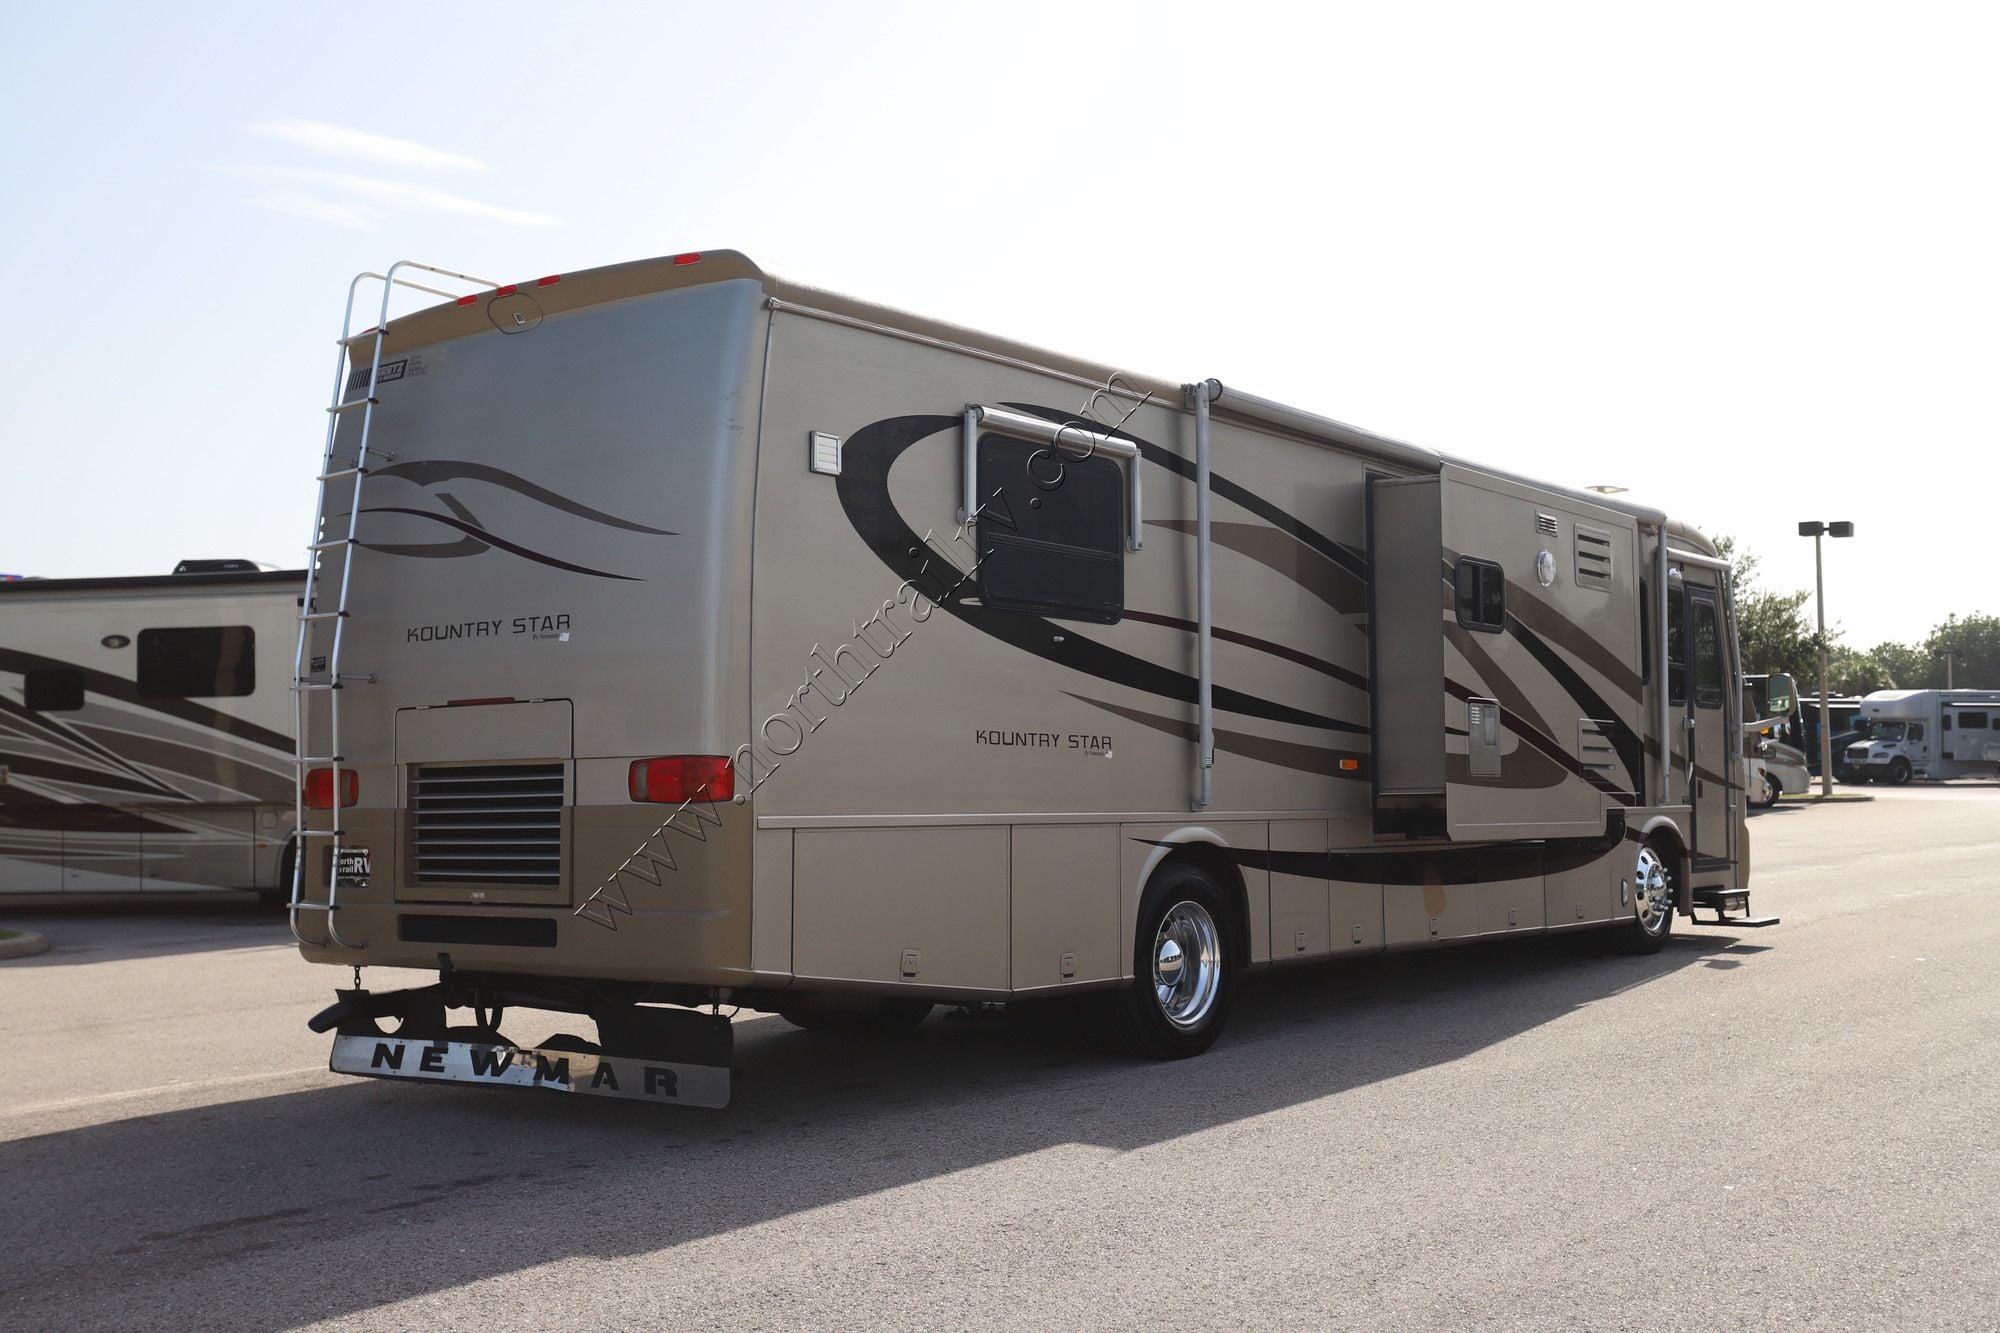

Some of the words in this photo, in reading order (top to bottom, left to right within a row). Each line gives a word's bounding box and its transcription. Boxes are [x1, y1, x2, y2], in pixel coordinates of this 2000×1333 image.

[407, 620, 502, 643] KOUNTRY
[512, 614, 570, 634] STAR
[976, 730, 1060, 748] KOUNTRY
[1068, 734, 1112, 749] STAR
[339, 857, 354, 865] orth
[354, 857, 371, 873] RV
[370, 1042, 678, 1098] NEWMAR
